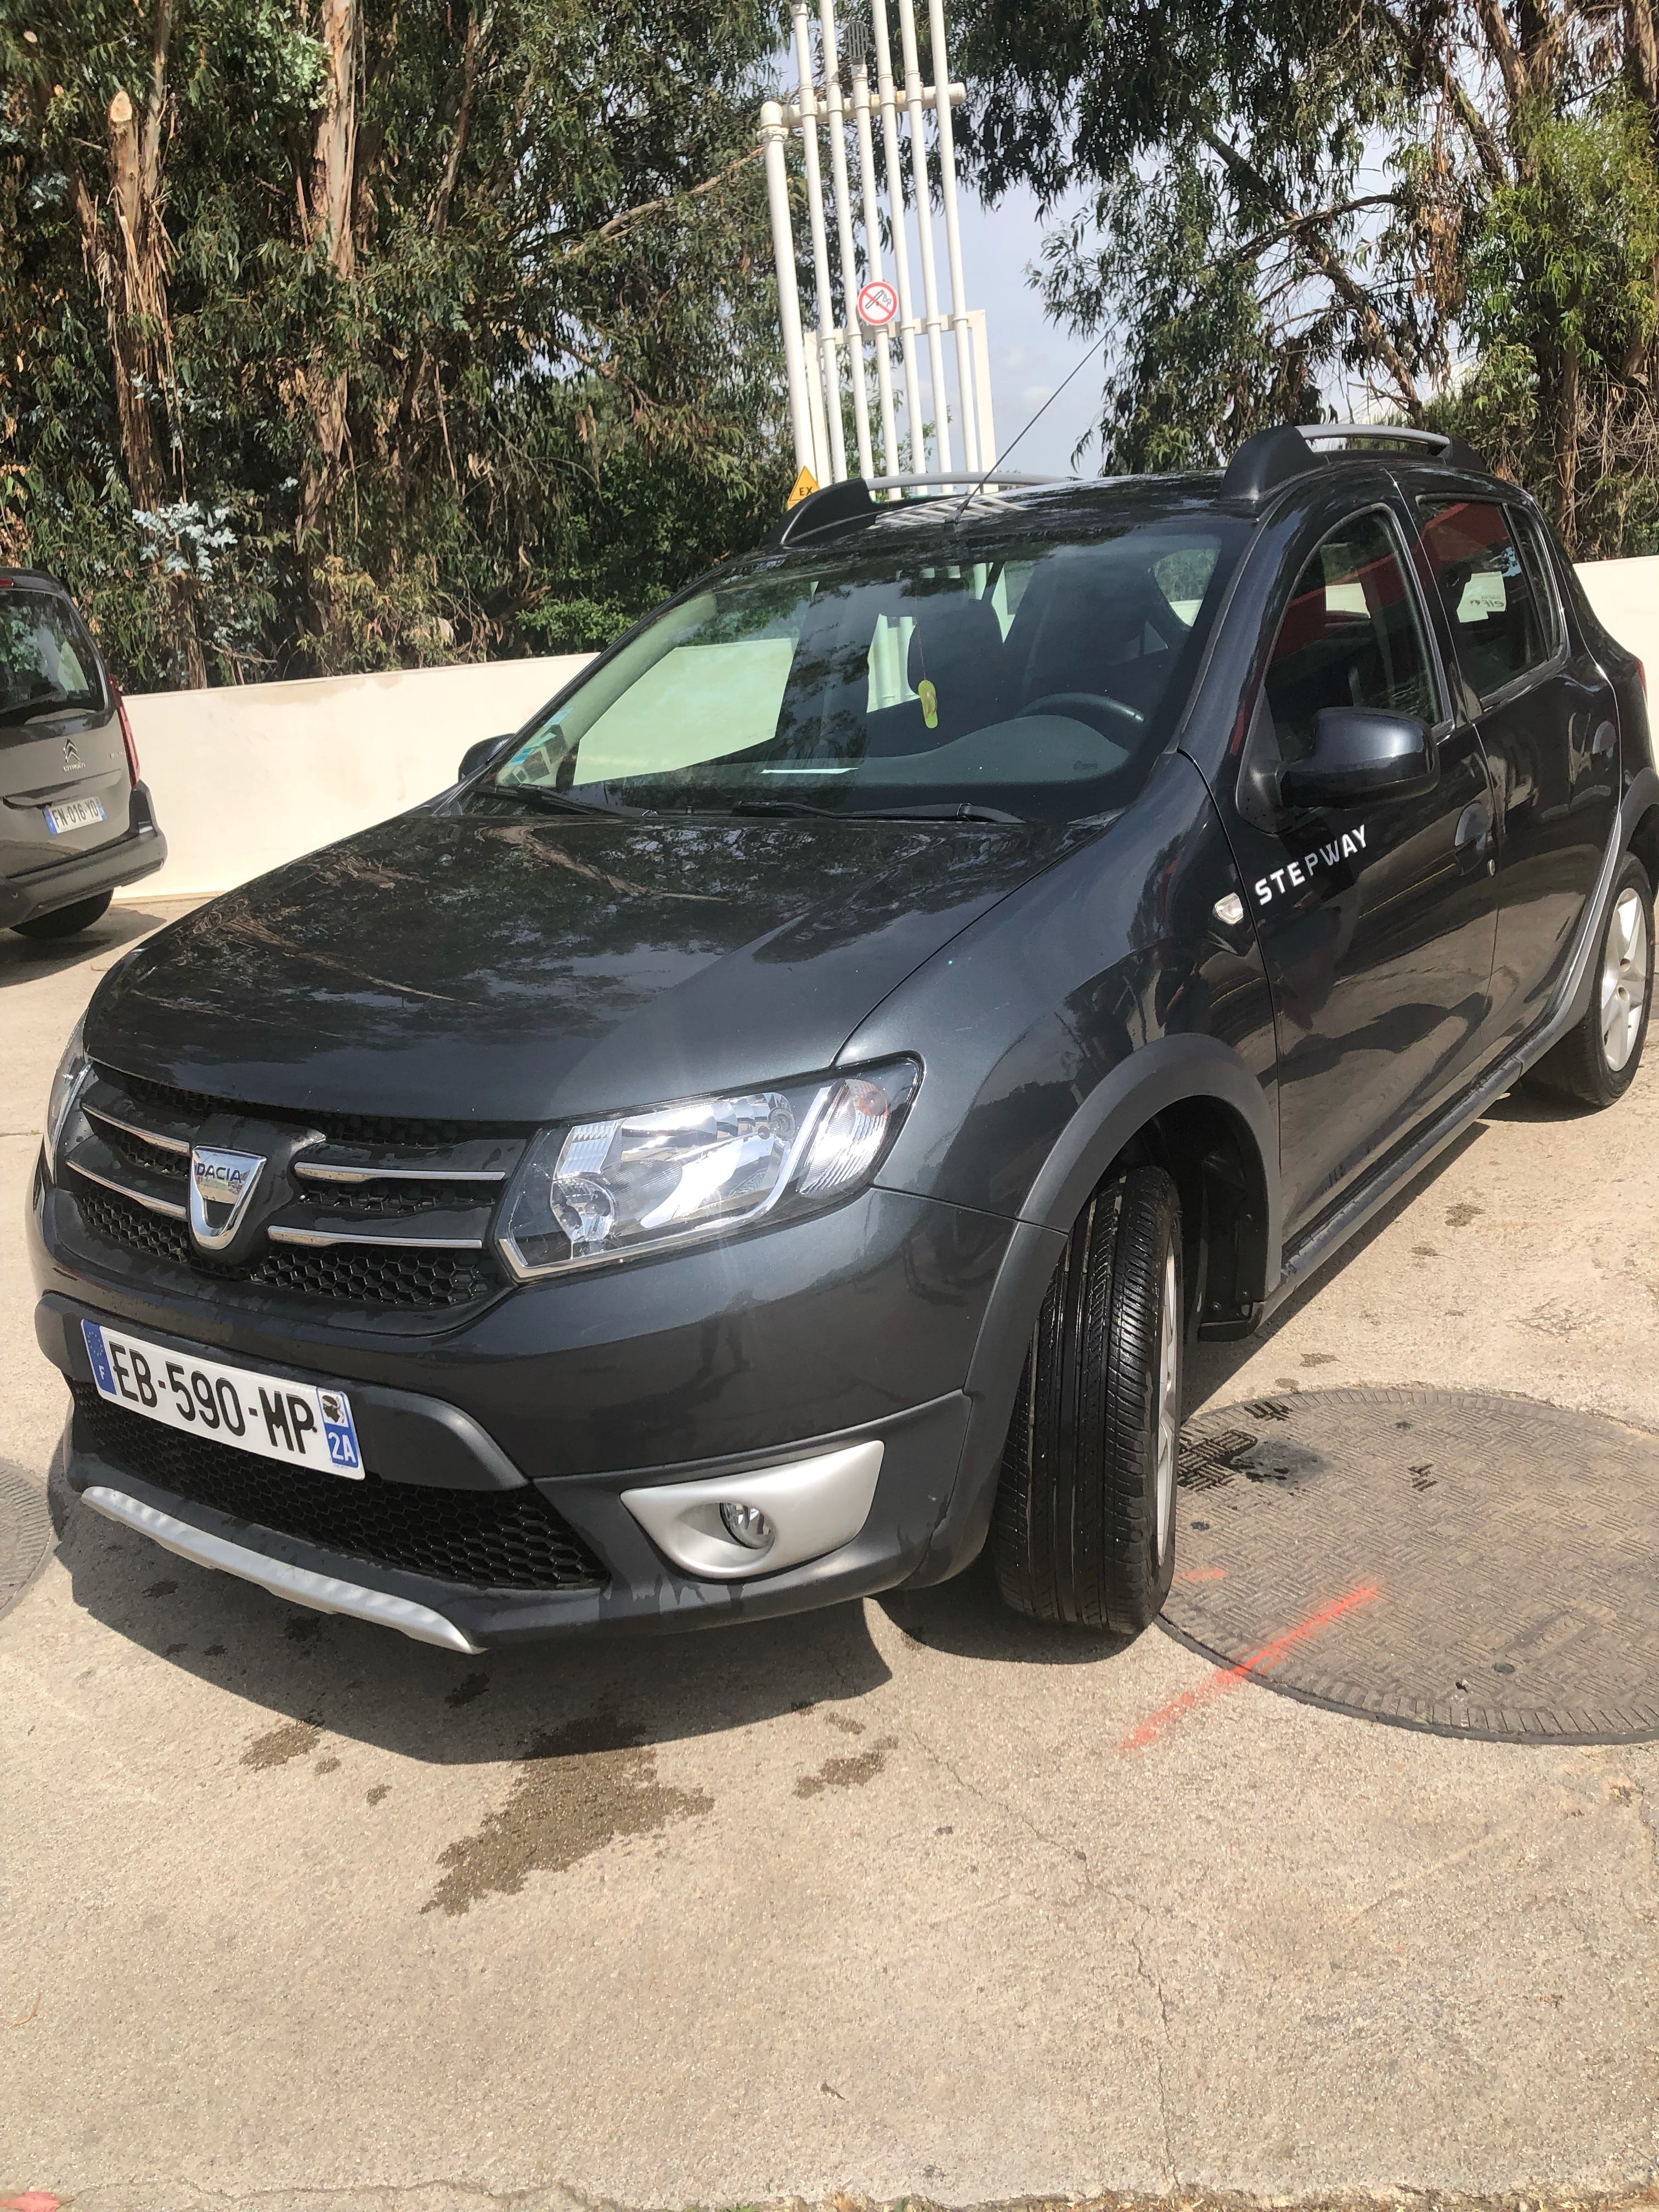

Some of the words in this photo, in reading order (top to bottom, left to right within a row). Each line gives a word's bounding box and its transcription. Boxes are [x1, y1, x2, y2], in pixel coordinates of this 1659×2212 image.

[799, 486, 813, 496] EX
[1254, 824, 1367, 906] STEPWAY
[196, 1163, 241, 1183] DACIA
[98, 1365, 105, 1380] F
[109, 1341, 315, 1454] EB-590-MP
[328, 1432, 356, 1463] 2A
